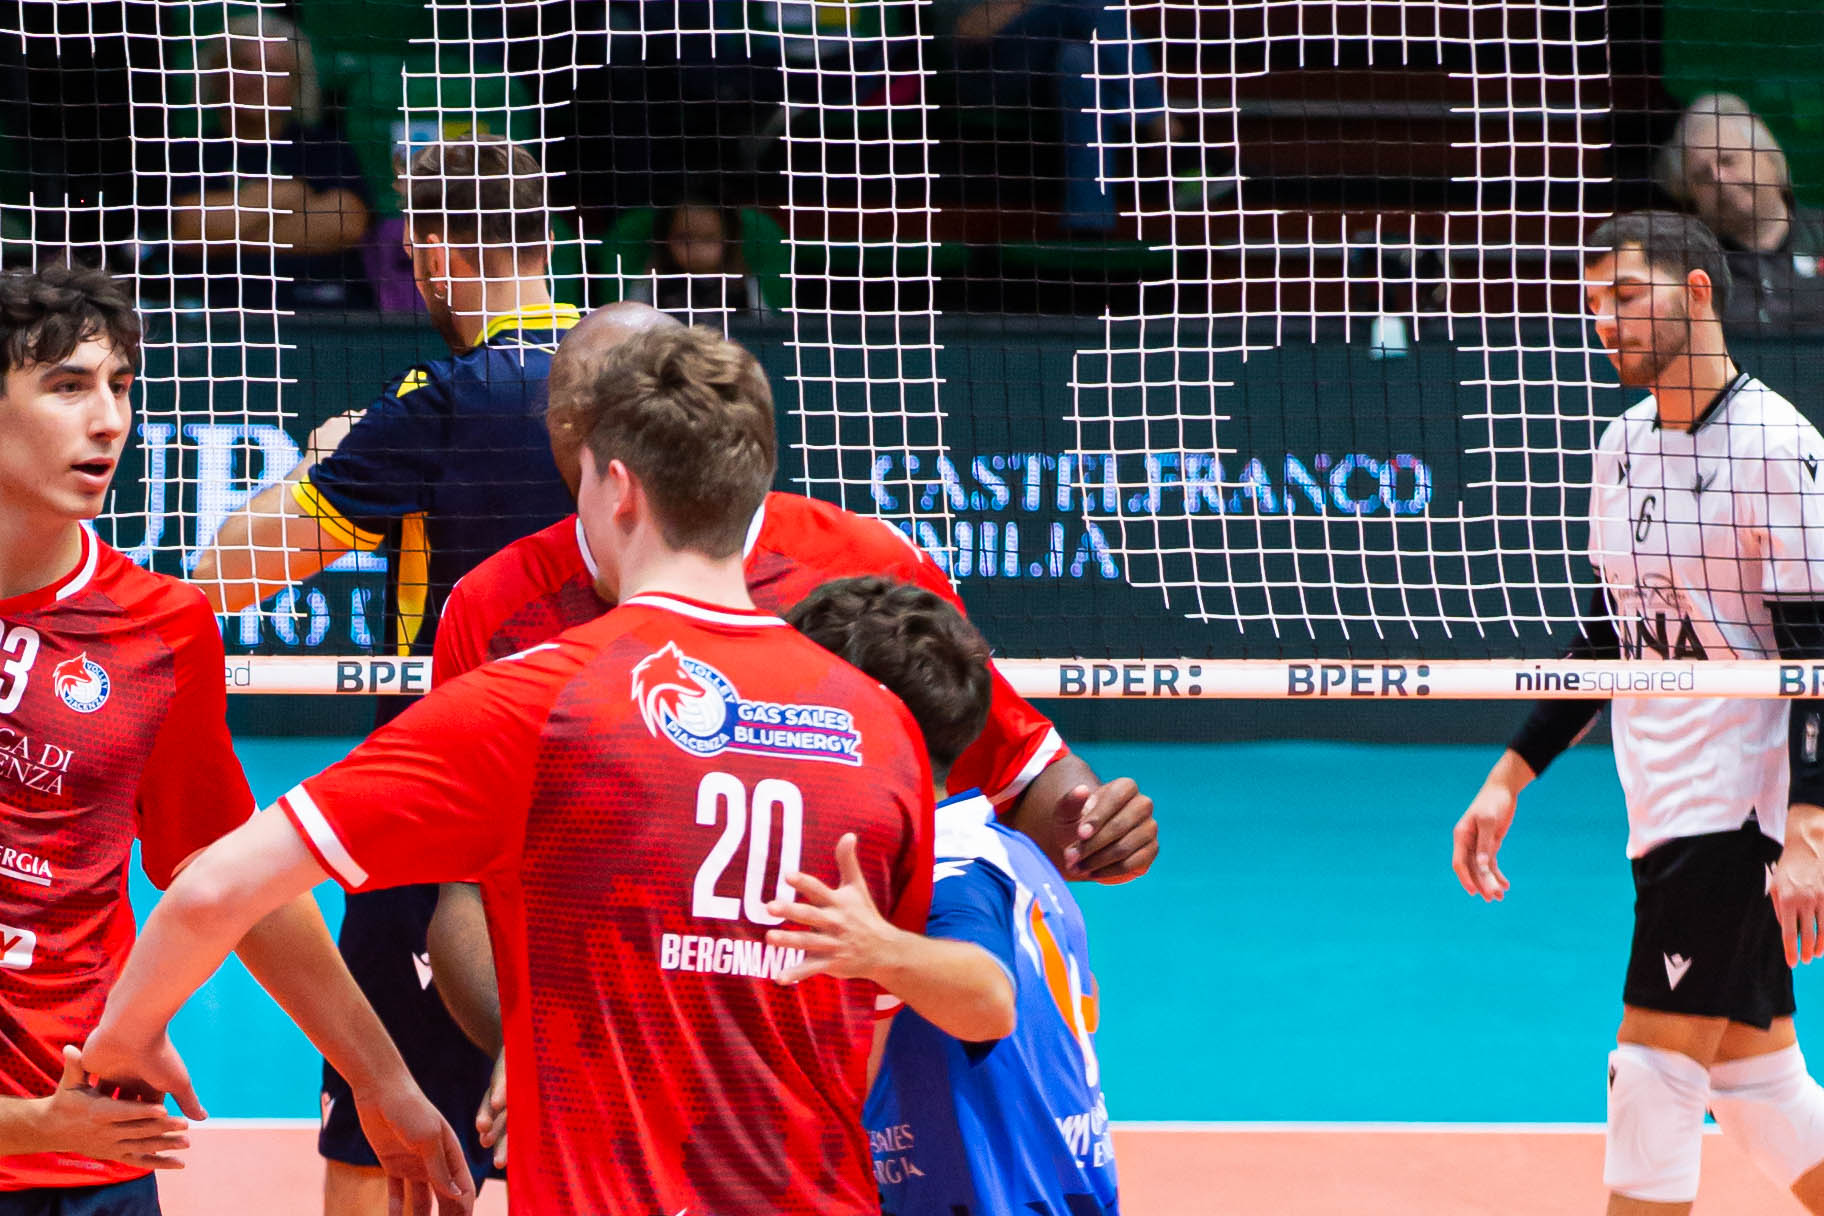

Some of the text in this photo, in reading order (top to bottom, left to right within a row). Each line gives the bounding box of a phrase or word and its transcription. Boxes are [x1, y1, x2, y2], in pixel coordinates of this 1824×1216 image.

[1635, 495, 1657, 543] 6
[1515, 664, 1694, 696] ninesquared
[737, 704, 850, 732] GAS SALES
[666, 720, 730, 752] PIACENZA
[733, 726, 855, 755] BLUENERGY
[39, 743, 75, 773] DI
[691, 771, 803, 926] 20
